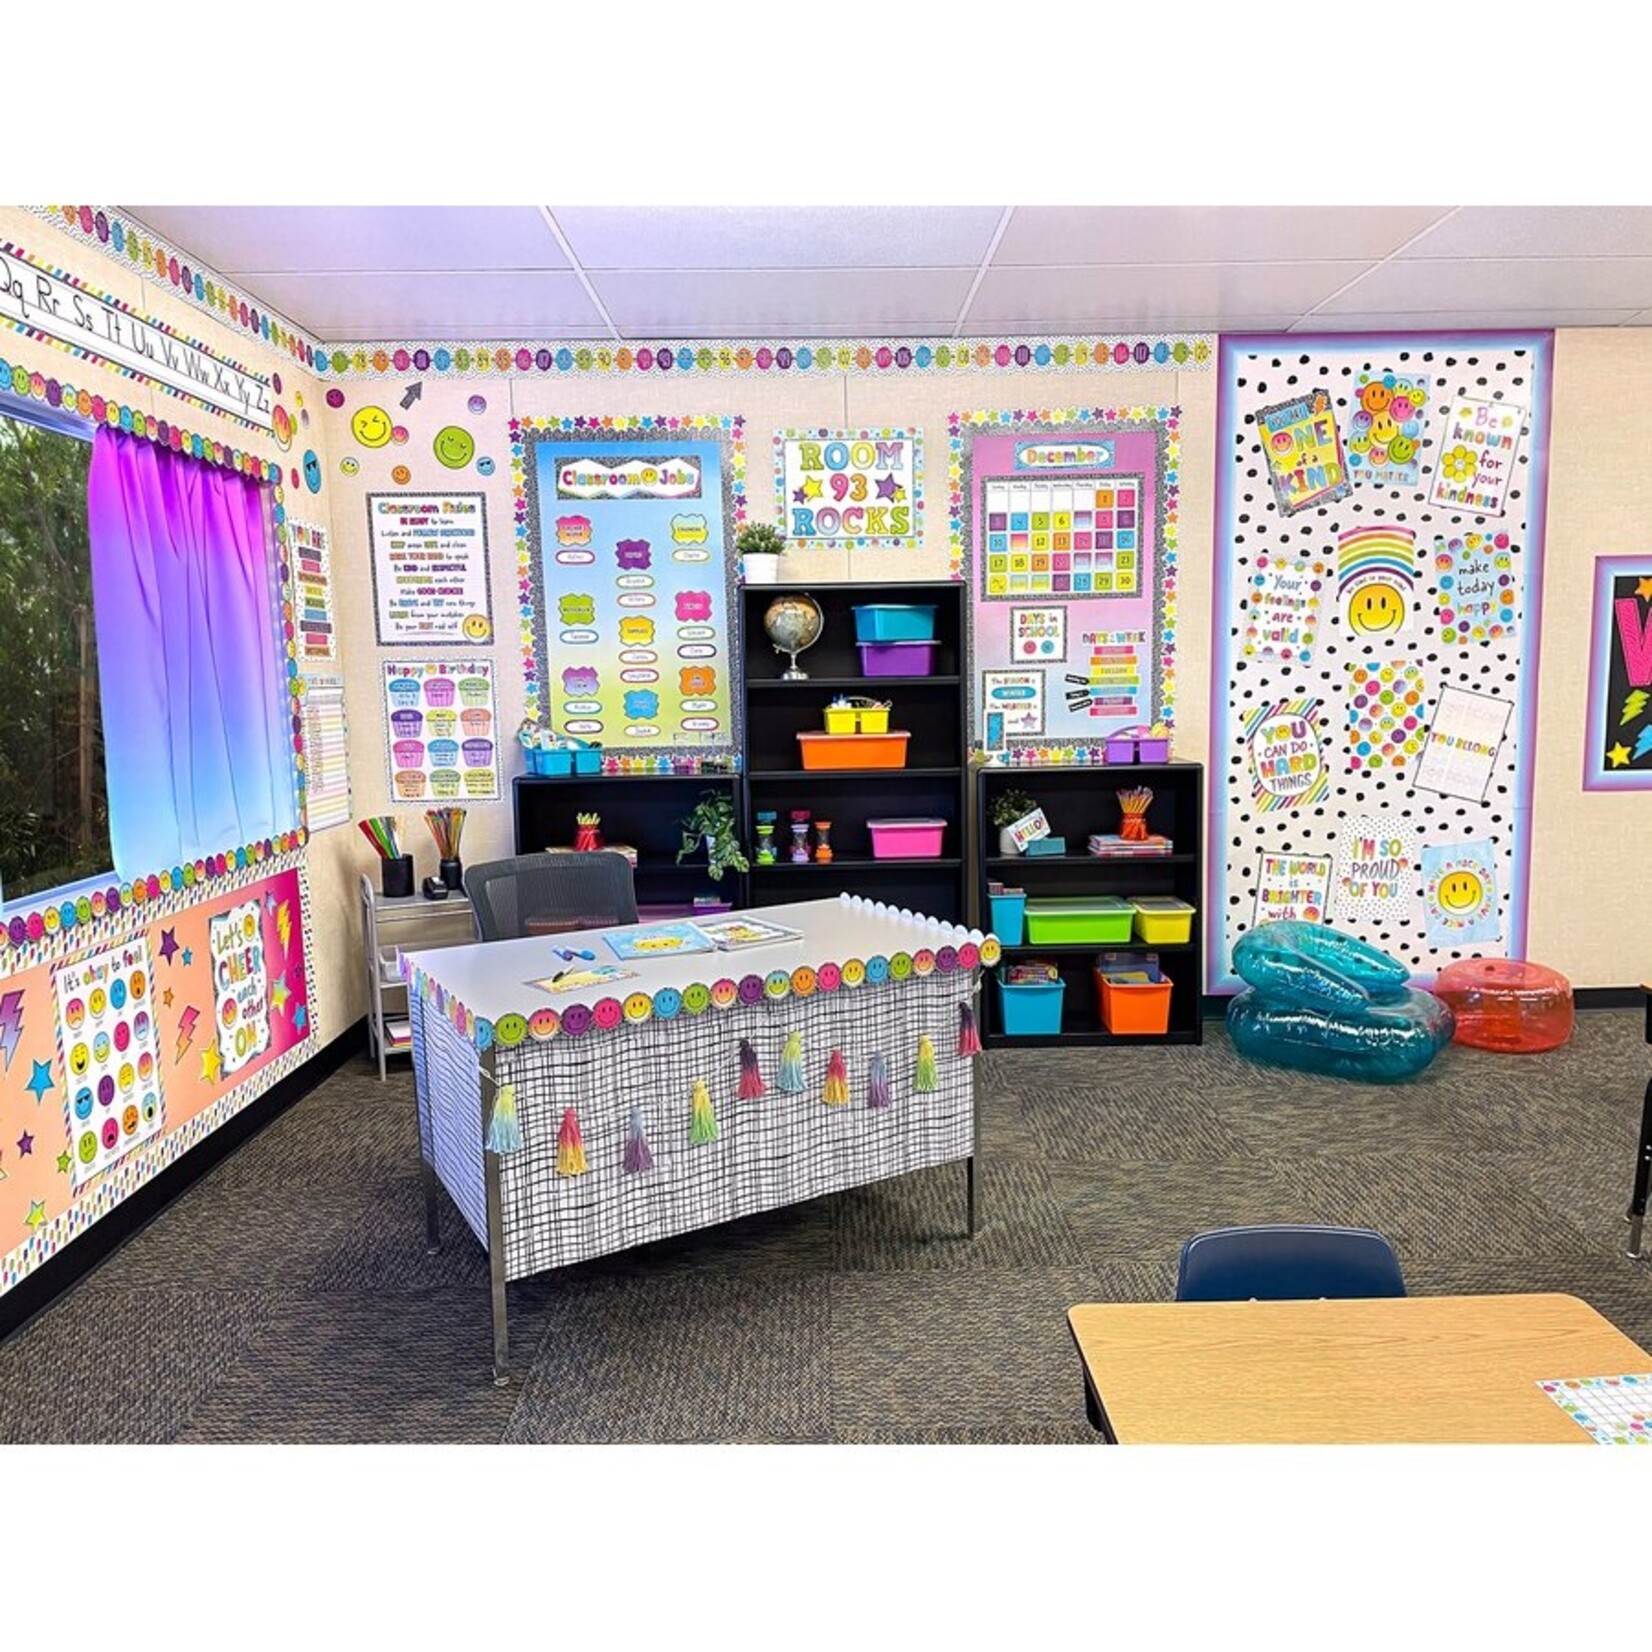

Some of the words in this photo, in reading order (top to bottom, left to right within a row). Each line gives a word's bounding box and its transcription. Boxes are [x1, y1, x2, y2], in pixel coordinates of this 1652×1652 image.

[37, 276, 60, 314] Rr
[73, 295, 93, 331] Ss
[101, 308, 121, 343] Tt
[132, 322, 153, 358] Uu
[160, 338, 179, 370] Vv
[184, 349, 209, 383] Ww
[214, 364, 232, 396] Xx
[235, 373, 251, 414] Yy
[256, 386, 270, 413] Zz
[1476, 407, 1498, 428] Be
[1453, 422, 1512, 450] known
[799, 442, 904, 470] ROOM
[1027, 447, 1104, 464] December
[1479, 449, 1502, 468] for
[562, 469, 641, 486] Classroom
[659, 468, 694, 486] Jobs
[1280, 462, 1342, 495] KIND
[1472, 472, 1502, 488] your
[830, 473, 868, 502] 93
[1436, 482, 1498, 508] kindness
[792, 506, 910, 536] ROCKS
[1459, 560, 1489, 575] make
[1274, 574, 1302, 590] Your
[1458, 578, 1494, 596] today
[1264, 592, 1306, 611] feelings
[1457, 602, 1497, 616] happy
[1020, 613, 1045, 624] DAYS
[1049, 612, 1058, 622] in
[1272, 612, 1294, 622] are
[1018, 626, 1060, 638] SCHOOL
[1083, 632, 1108, 644] DAYS
[1116, 632, 1146, 642] WEEK
[1262, 627, 1298, 644] valid
[388, 664, 424, 678] Happy
[438, 664, 489, 677] Birthday
[1262, 720, 1306, 744] YOU
[1264, 744, 1288, 758] CAN
[1290, 741, 1307, 754] DO
[1431, 732, 1454, 746] YOU
[1456, 738, 1496, 757] BELONG
[1260, 753, 1317, 778] HARD
[1269, 773, 1312, 792] THINGS
[1352, 836, 1375, 860] I'M
[1380, 839, 1402, 857] SO
[1266, 858, 1287, 876] THE
[1289, 860, 1326, 877] WORLD
[1352, 858, 1400, 880] PROUD
[1262, 888, 1322, 906] BRIGHTER
[1350, 882, 1368, 898] OF
[1372, 881, 1398, 899] YOU
[1268, 906, 1296, 920] with
[216, 922, 244, 954] Let's
[64, 971, 80, 994] It's
[83, 964, 108, 986] okay
[112, 956, 120, 972] to
[123, 945, 142, 968] feel
[219, 945, 260, 991] CHEER
[237, 976, 256, 1003] each
[242, 997, 263, 1020] other
[235, 1020, 257, 1058] ON
